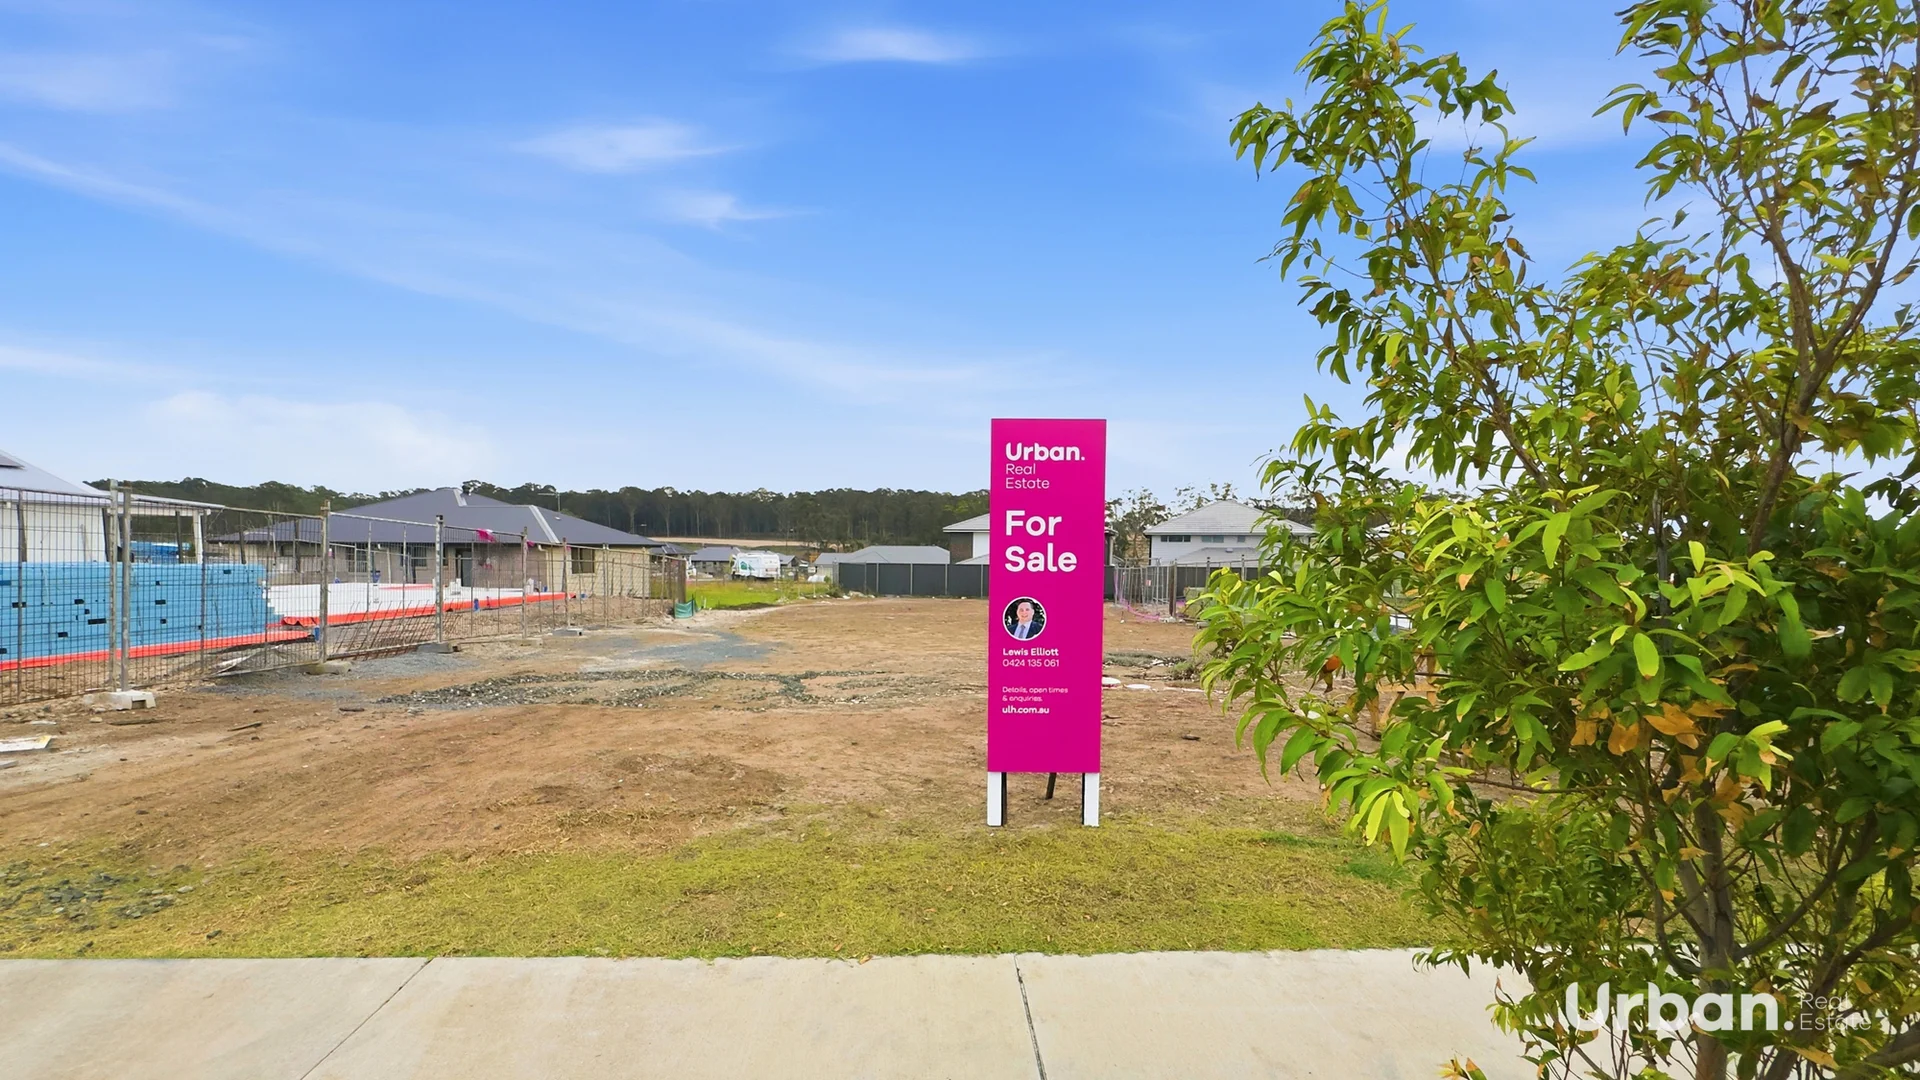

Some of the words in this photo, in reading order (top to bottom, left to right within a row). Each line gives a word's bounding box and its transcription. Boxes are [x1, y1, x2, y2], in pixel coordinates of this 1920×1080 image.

[1005, 442, 1086, 461] Urban.
[1005, 463, 1036, 475] Real
[1005, 477, 1050, 489] Estate
[1005, 510, 1063, 536] For
[1004, 542, 1078, 573] Sale
[1002, 648, 1029, 656] Lewis
[1030, 647, 1059, 656] Elliott
[1002, 659, 1026, 667] 0424
[1027, 659, 1042, 667] 135
[1043, 659, 1060, 667] 061
[1002, 705, 1050, 714] ulh.com.au
